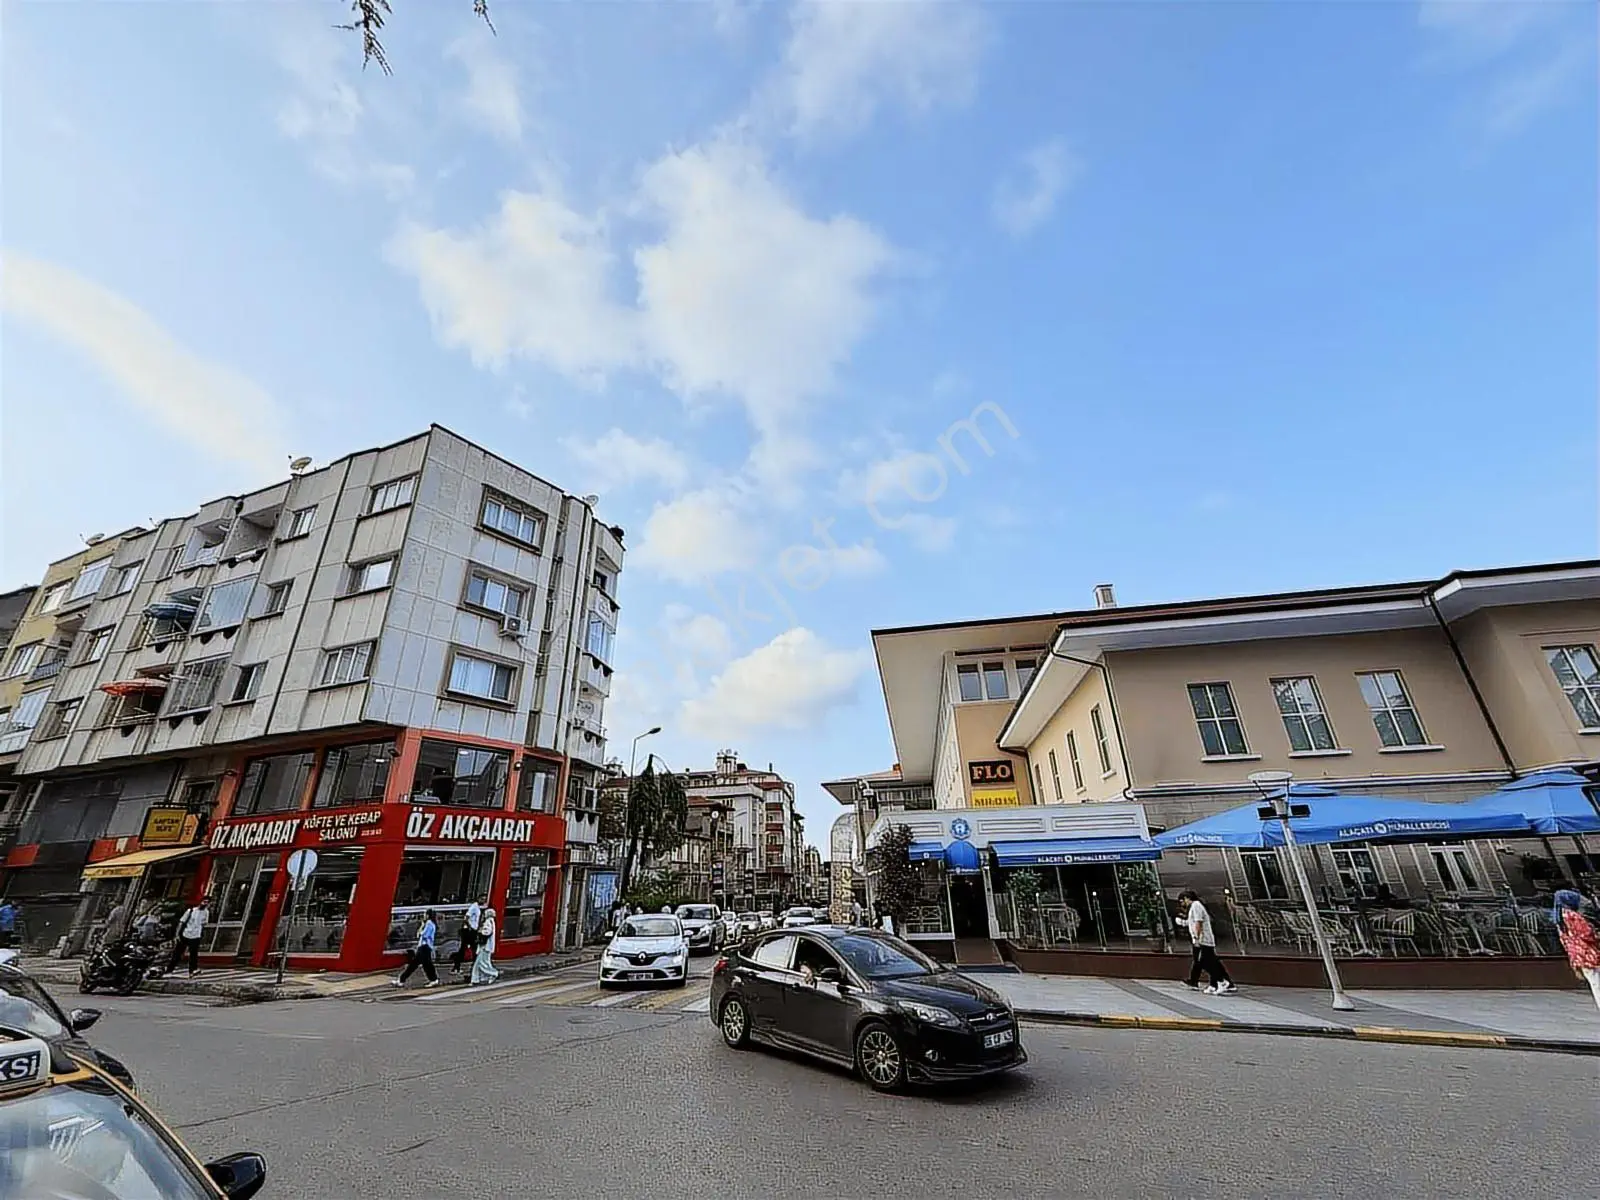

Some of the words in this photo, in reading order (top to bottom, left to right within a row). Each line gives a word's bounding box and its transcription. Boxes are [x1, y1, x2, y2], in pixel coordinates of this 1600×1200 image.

[972, 764, 1011, 780] FLO
[302, 814, 333, 829] KÖFTE
[334, 813, 347, 827] VE
[348, 811, 382, 826] KEBAP
[406, 806, 436, 838] ÖZ
[438, 814, 535, 843] AKÇAABAT
[210, 822, 230, 850] ÖZ
[227, 818, 301, 850] AKÇAABAT
[318, 827, 358, 842] SALONU
